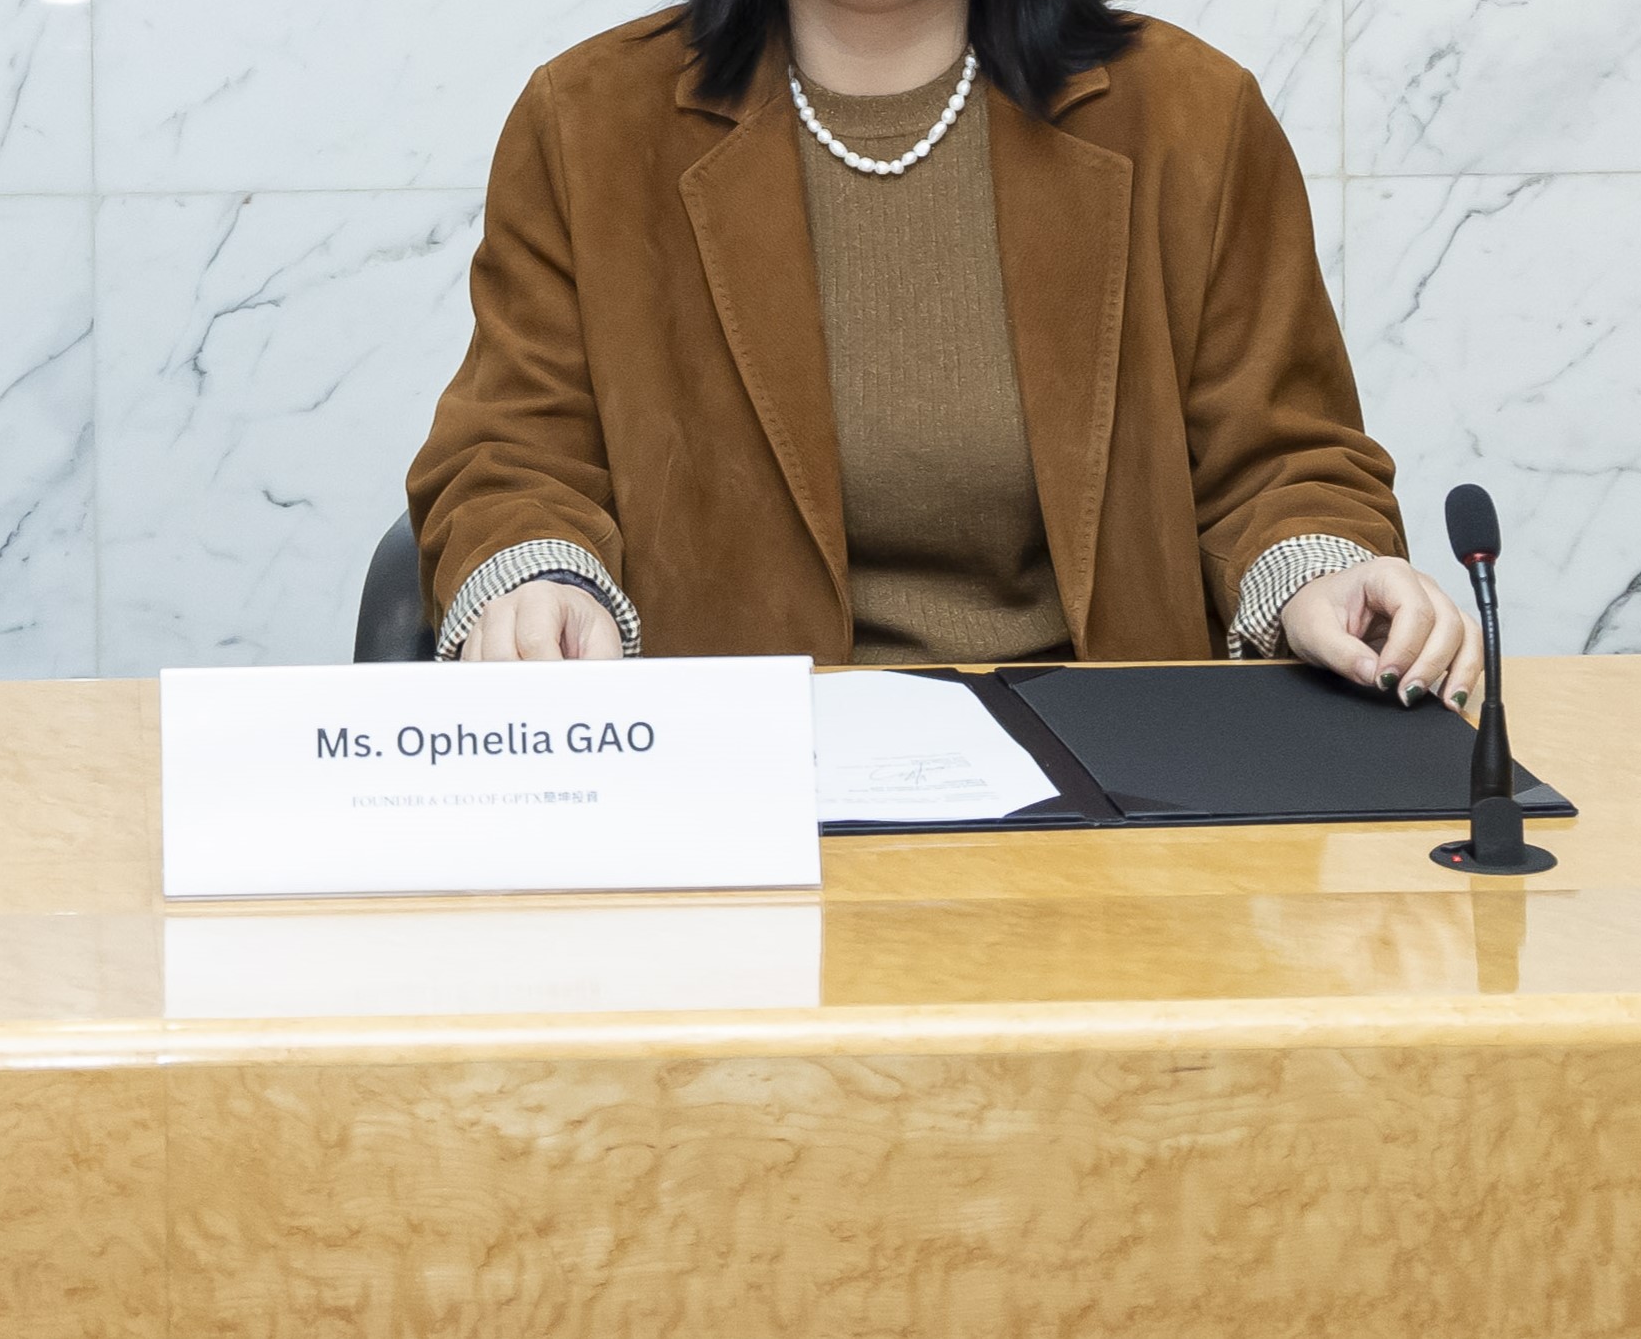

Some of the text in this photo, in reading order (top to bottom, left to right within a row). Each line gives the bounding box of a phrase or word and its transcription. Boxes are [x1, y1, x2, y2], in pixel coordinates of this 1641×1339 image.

[316, 721, 655, 766] Ms. Ophelia GAO
[352, 794, 425, 808] FOUNDER
[442, 793, 475, 806] CEO
[478, 793, 498, 805] OF
